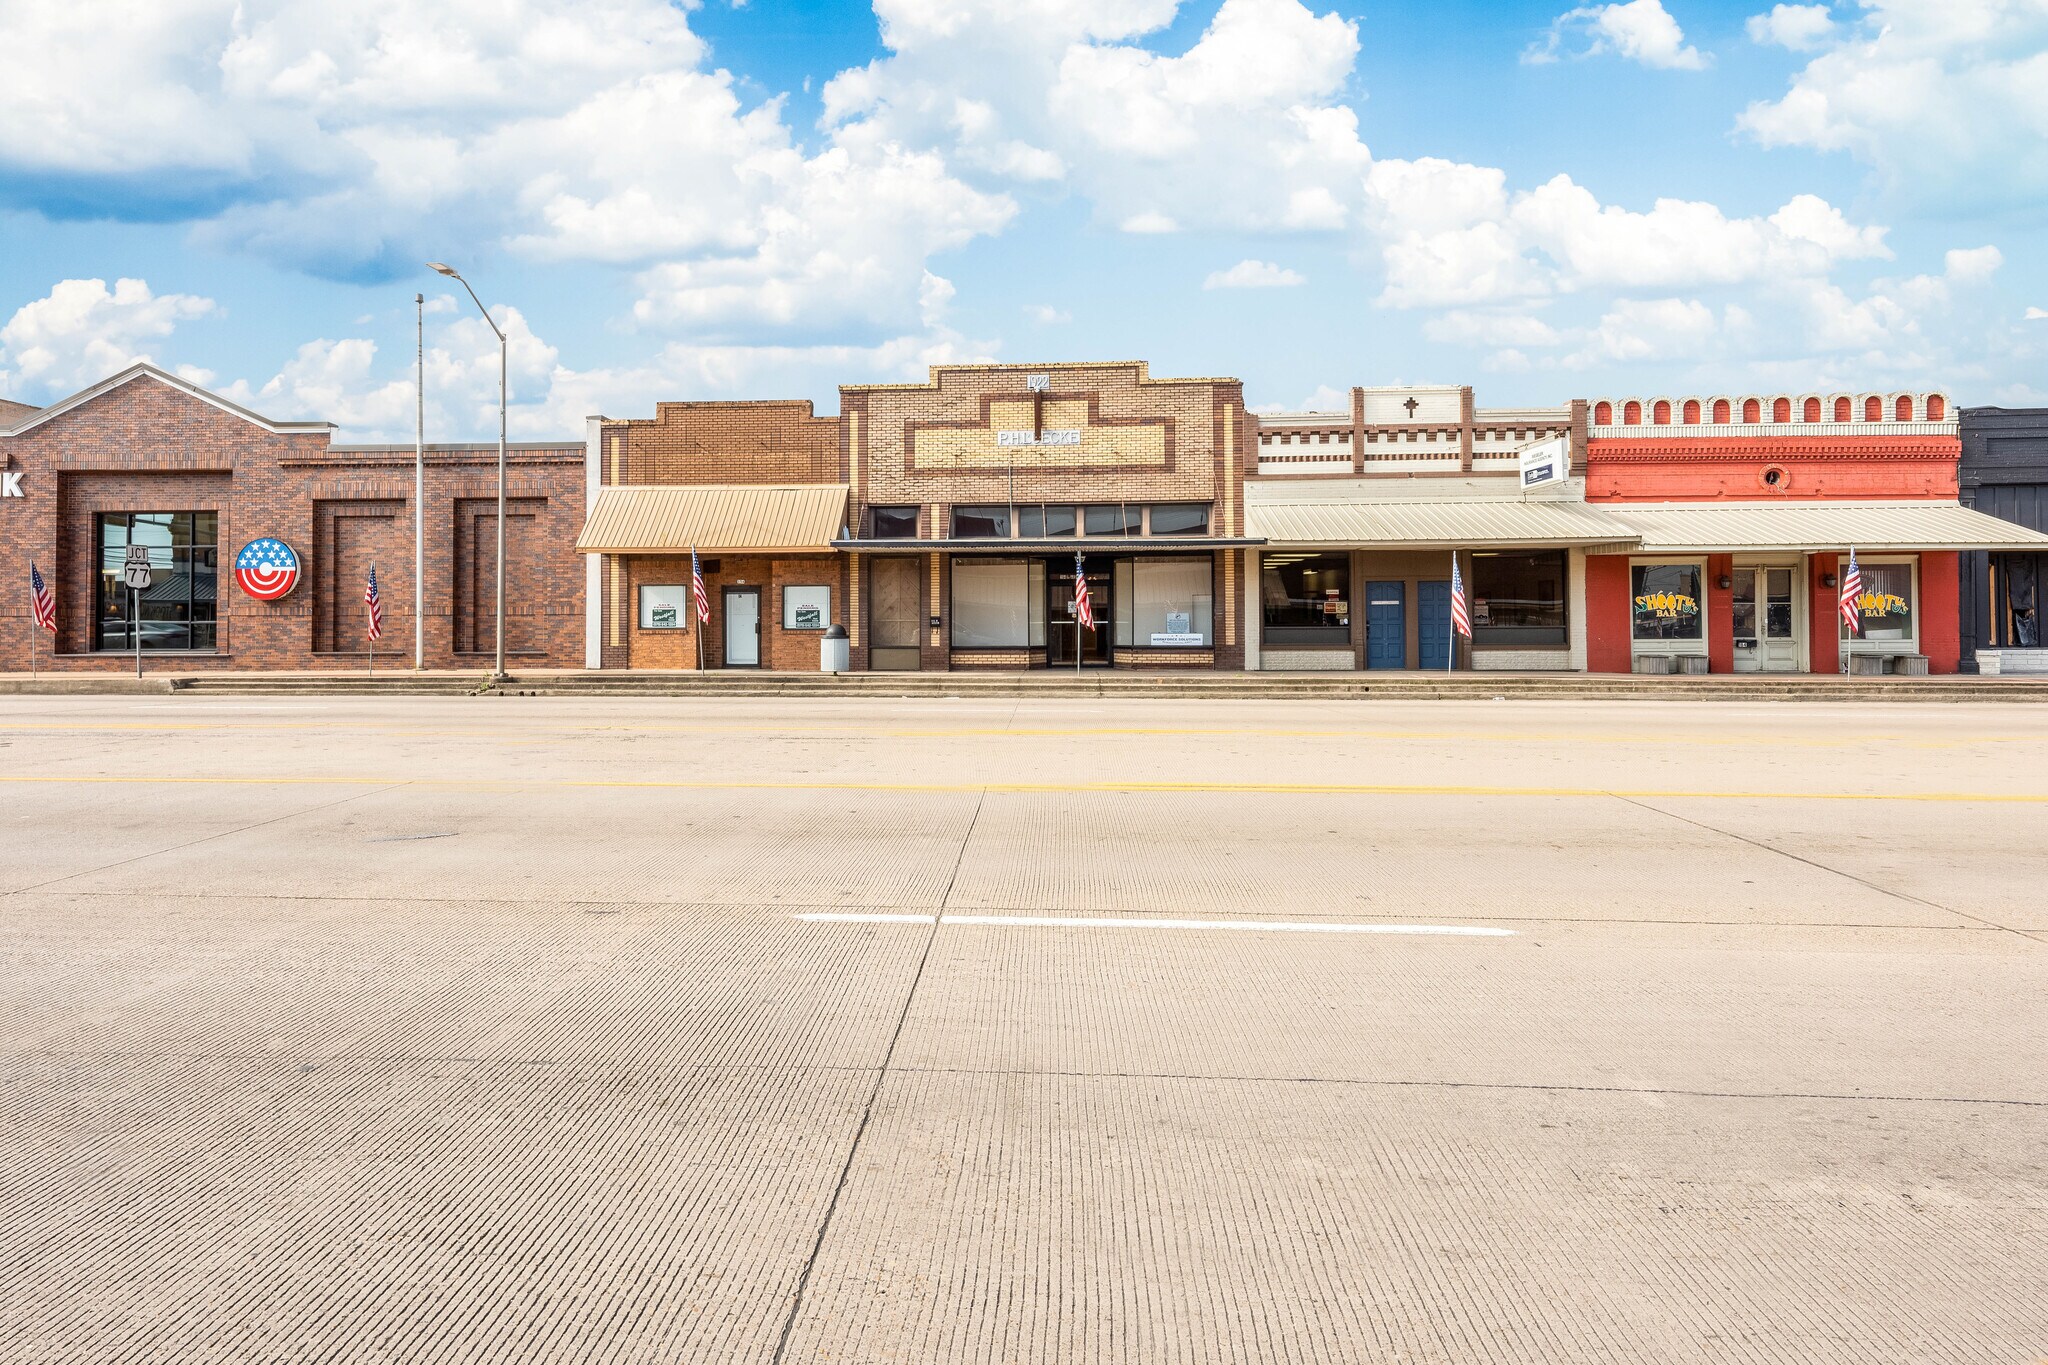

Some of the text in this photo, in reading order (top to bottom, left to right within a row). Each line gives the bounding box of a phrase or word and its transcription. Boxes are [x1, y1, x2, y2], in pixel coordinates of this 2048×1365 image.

[1029, 376, 1049, 389] 1922
[0, 472, 25, 497] K
[128, 547, 147, 559] JCT
[127, 568, 149, 583] 77
[1864, 609, 1886, 617] BAR
